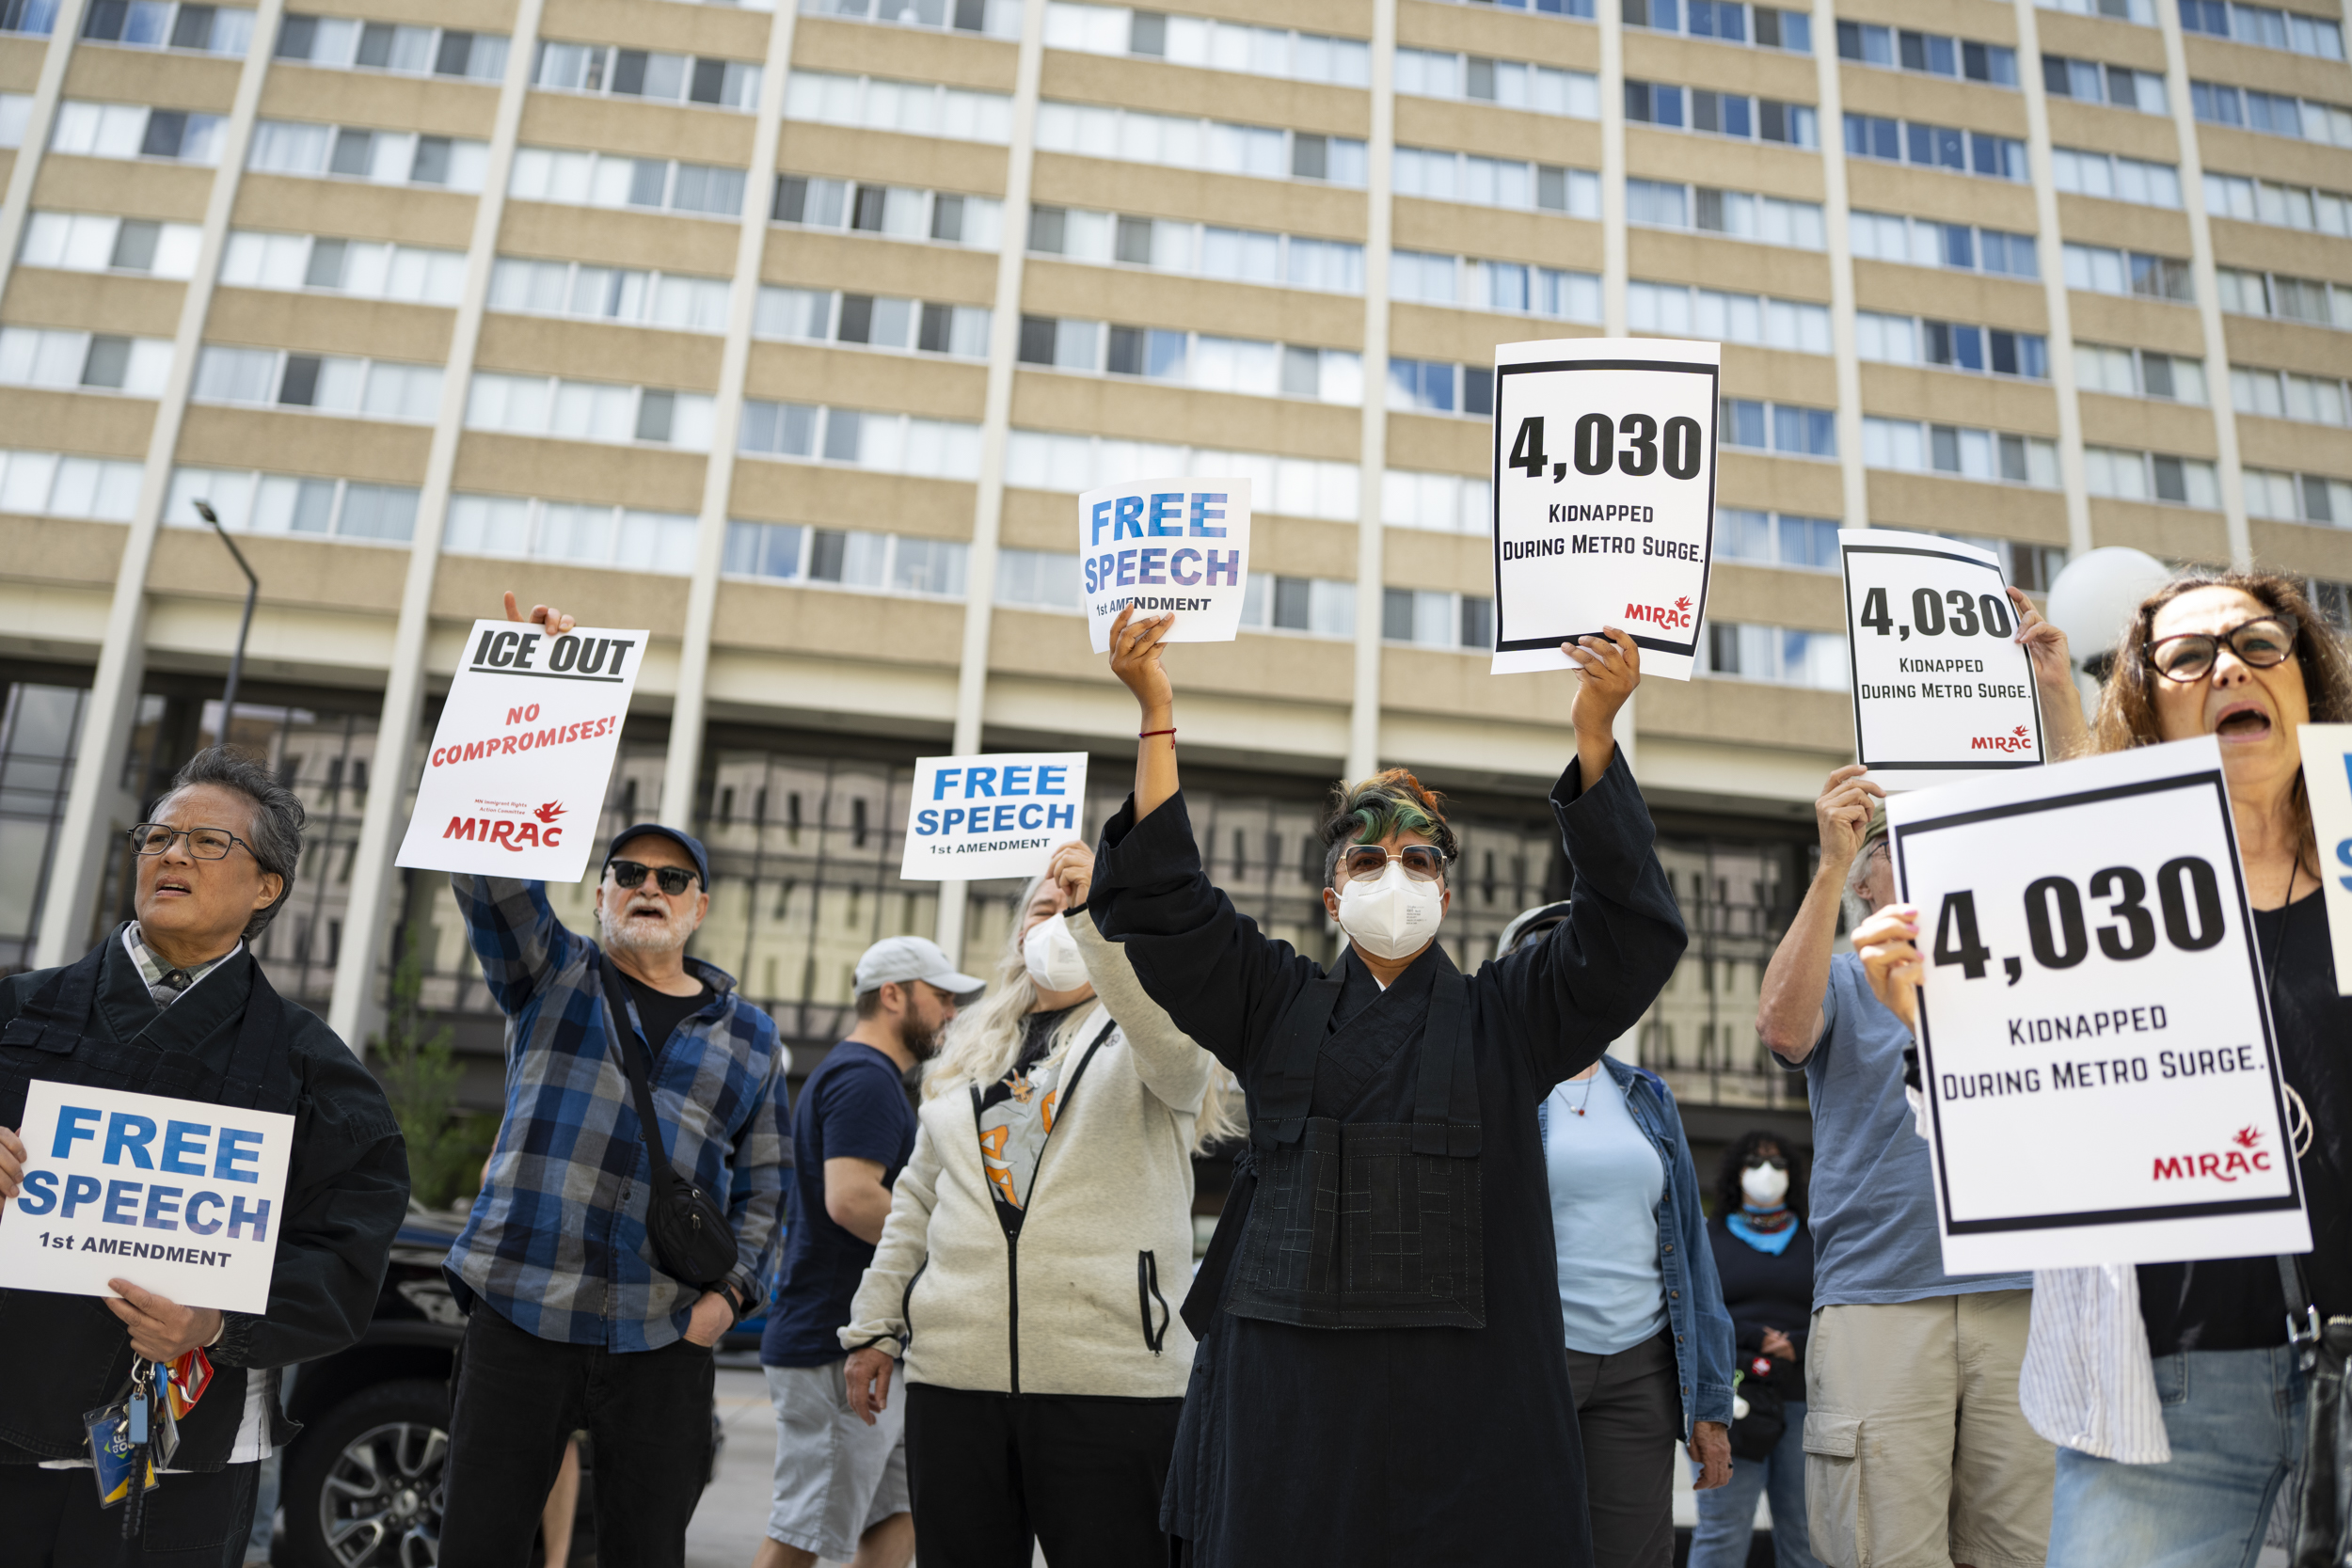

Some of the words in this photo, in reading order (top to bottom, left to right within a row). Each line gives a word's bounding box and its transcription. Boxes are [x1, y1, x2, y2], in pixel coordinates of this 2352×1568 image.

[1508, 412, 1702, 484] 4,030
[1091, 492, 1229, 546] FREE
[1084, 547, 1240, 594] SPEECH
[1096, 603, 1108, 617] 1st
[1624, 602, 1692, 630] MIRAC
[1860, 587, 2013, 642] 4,030
[472, 629, 542, 670] ICE
[548, 635, 636, 675] OUT
[505, 703, 540, 726] NO
[432, 715, 617, 768] COMPROMISES!
[1971, 736, 2032, 753] MIRAC
[932, 765, 1068, 801] FREE
[442, 816, 563, 852] MIRAC
[914, 803, 1075, 836] SPEECH
[929, 845, 952, 855] 1st
[956, 837, 1051, 854] AMENDMENT
[1932, 855, 2227, 987] 4,030
[50, 1104, 265, 1185] FREE
[2153, 1151, 2272, 1182] MIRAC
[16, 1169, 272, 1243] SPEECH
[38, 1231, 75, 1251] 1st
[80, 1236, 232, 1268] AMENDMENT
